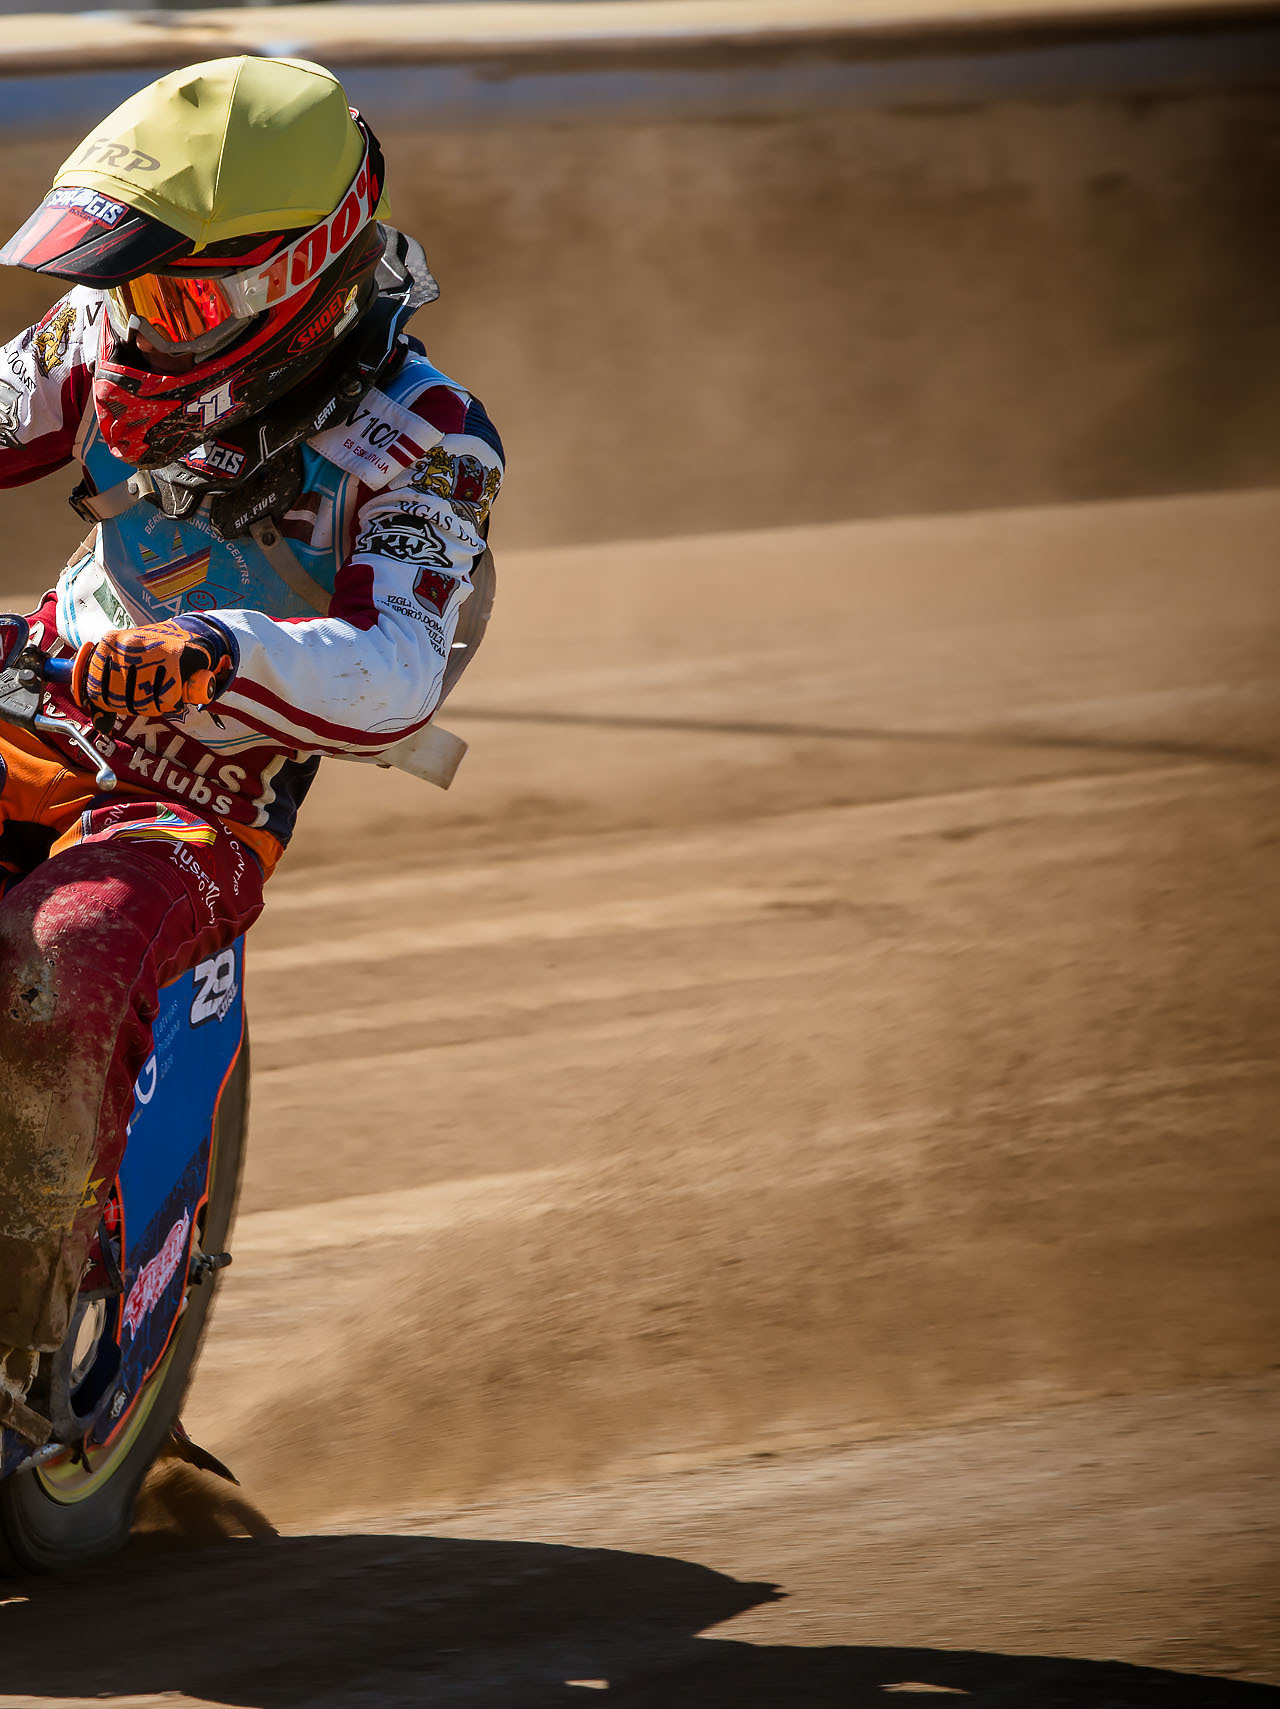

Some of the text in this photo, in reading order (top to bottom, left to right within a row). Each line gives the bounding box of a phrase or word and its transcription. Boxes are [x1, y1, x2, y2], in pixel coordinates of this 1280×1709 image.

[297, 294, 343, 347] SHOEI
[225, 542, 251, 586] CENTRS
[127, 746, 233, 816] klubs
